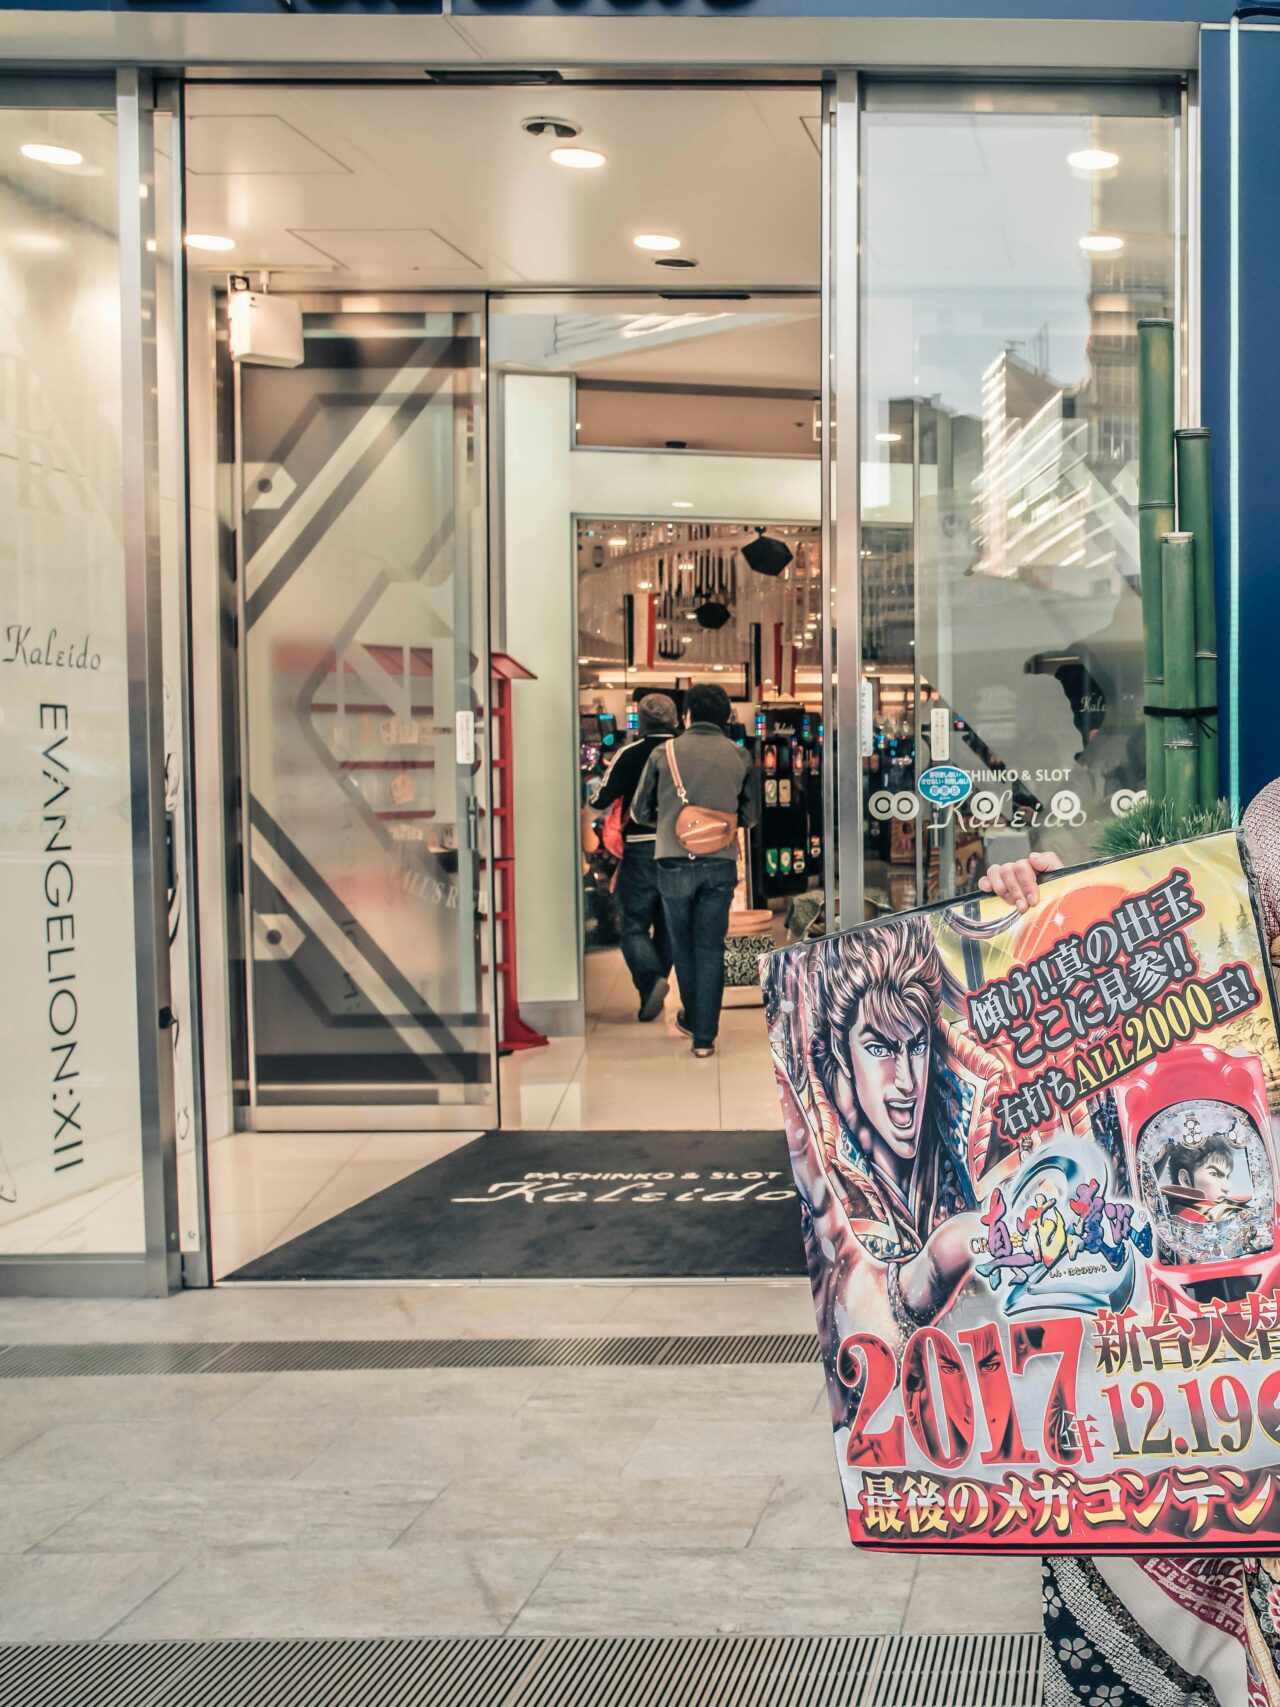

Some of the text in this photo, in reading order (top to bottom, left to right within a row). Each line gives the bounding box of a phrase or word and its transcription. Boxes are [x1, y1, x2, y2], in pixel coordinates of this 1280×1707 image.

[3, 624, 101, 670] Kaleido
[1022, 769, 1032, 782] &
[1036, 768, 1072, 782] SLOT
[39, 702, 83, 1172] EVANGELION:XII
[451, 1180, 798, 1204] Kaleido
[523, 1171, 783, 1181] PACHINKO & SLOT
[1102, 1374, 1256, 1461] 12.19
